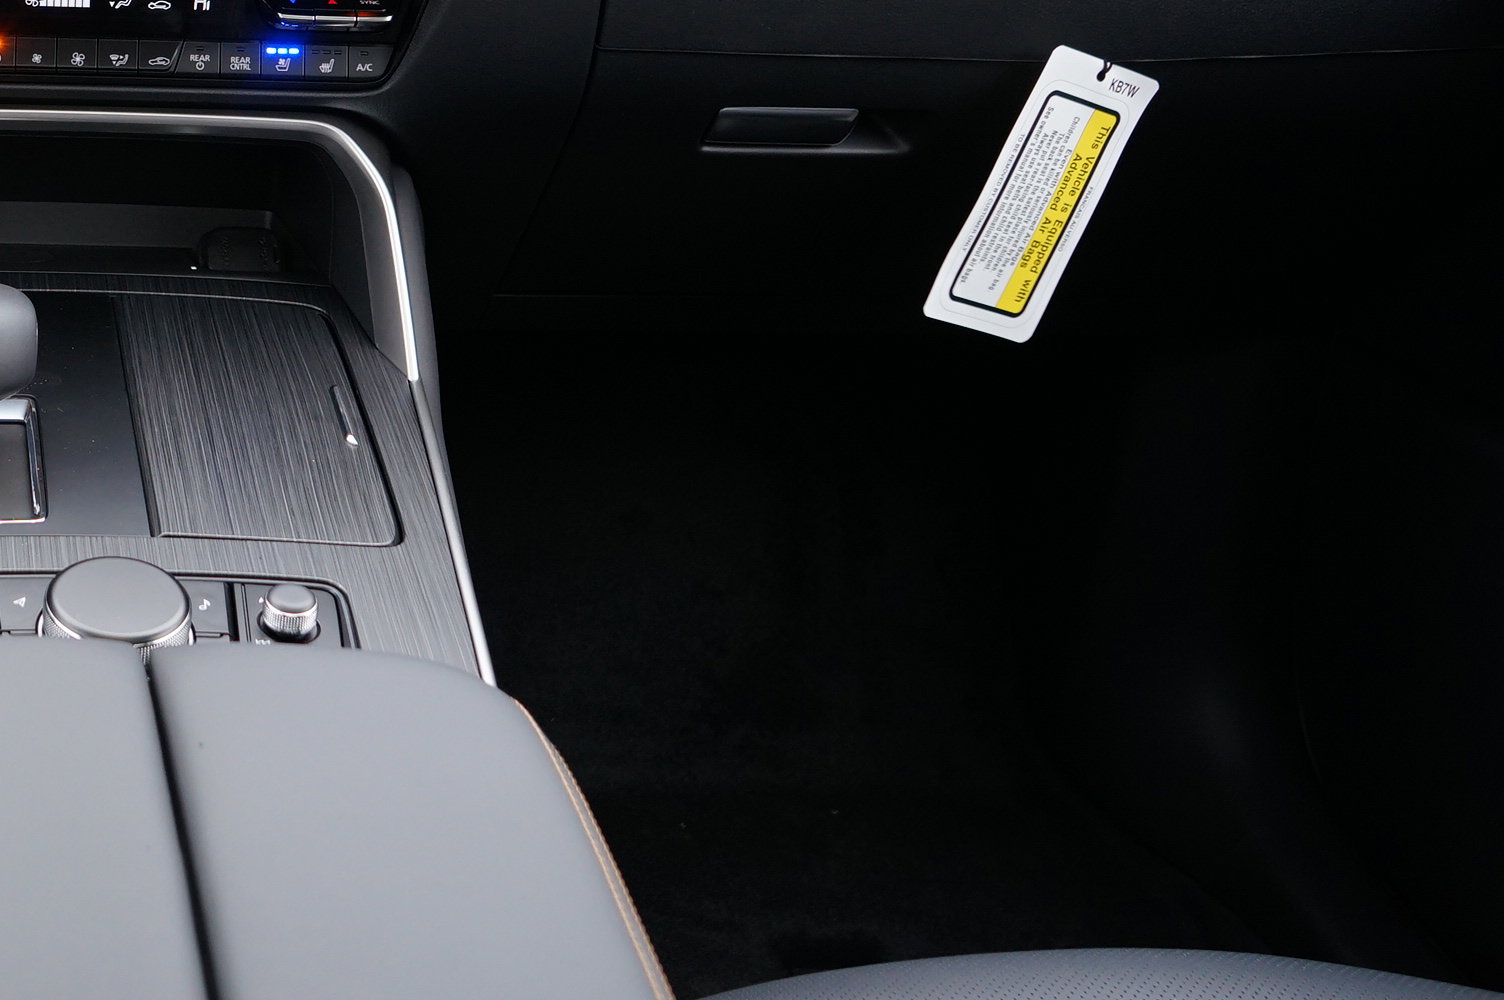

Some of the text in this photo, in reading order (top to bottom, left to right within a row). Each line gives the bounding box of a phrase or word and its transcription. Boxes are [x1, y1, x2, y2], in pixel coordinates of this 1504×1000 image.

[190, 54, 210, 62] REAR
[229, 63, 251, 71] CNTRL
[230, 56, 251, 64] REAR
[356, 63, 373, 72] A/C
[1108, 77, 1141, 98] KB7W
[961, 133, 1025, 251] TO BE REMOVED BY CUSTOMER ONLY
[1008, 148, 1072, 266] Even with Advanced Air Bags
[1014, 124, 1110, 303] This Vehicle is Equipped with
[1017, 152, 1084, 269] Advanced Air Bags
